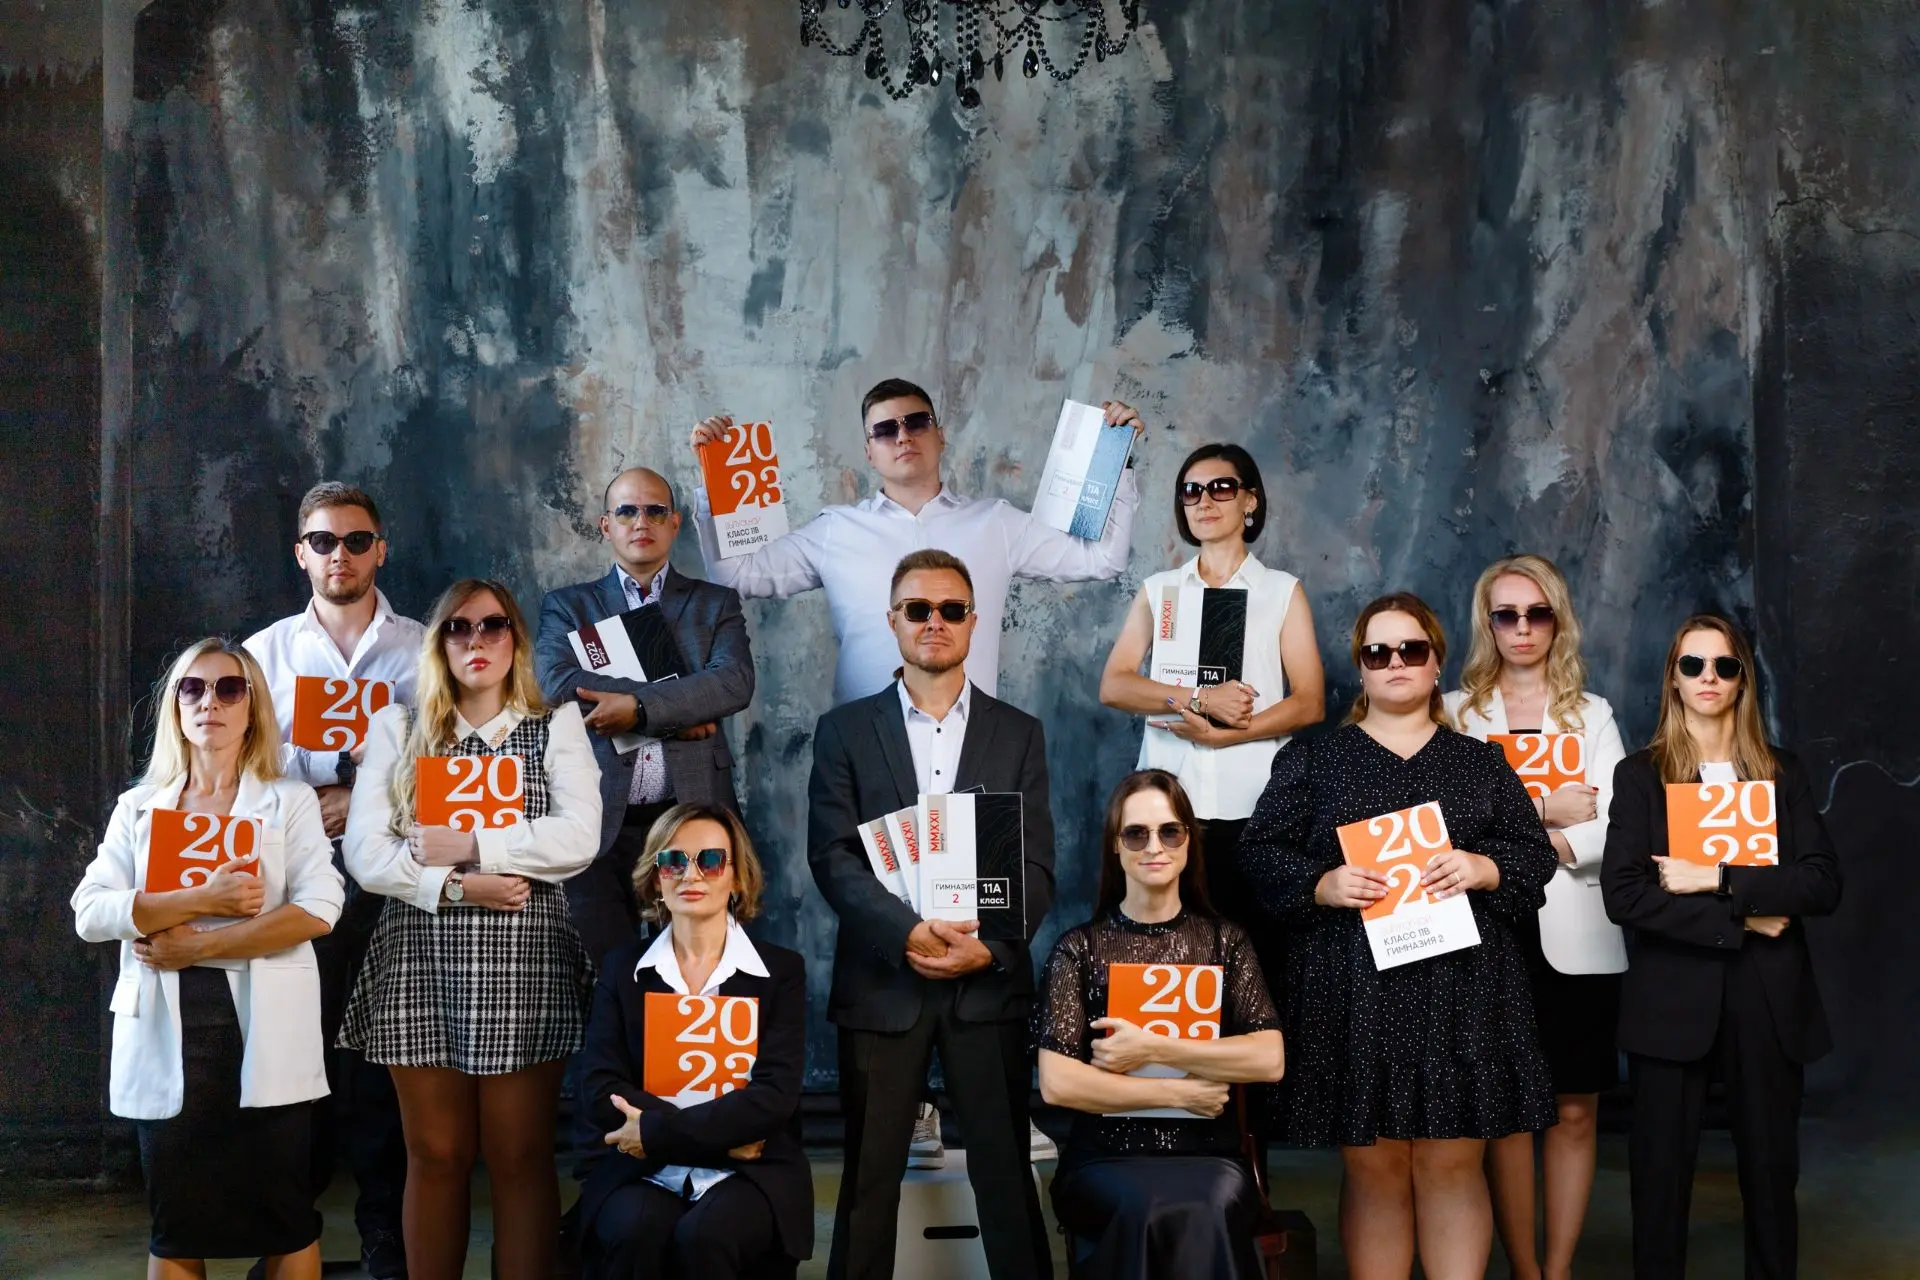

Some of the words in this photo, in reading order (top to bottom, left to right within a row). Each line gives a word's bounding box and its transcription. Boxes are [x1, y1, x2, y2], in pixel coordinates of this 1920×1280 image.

[725, 422, 777, 466] 20
[731, 466, 783, 512] 23
[726, 528, 750, 539] КЛАСС
[728, 536, 764, 548] ГИМНАЗИЯ
[763, 535, 769, 543] 2
[1160, 600, 1172, 639] MMXXII
[585, 641, 601, 667] 2022
[1162, 668, 1197, 676] ГИМНАЗИЯ
[1203, 670, 1219, 681] 11А
[320, 678, 395, 720] 20
[1515, 733, 1585, 776] 20
[444, 755, 524, 802] 20
[1698, 781, 1777, 828] 20
[179, 812, 262, 863] 20
[929, 809, 940, 852] MMXXII
[1368, 801, 1450, 863] 20
[875, 831, 896, 872] MMXXII
[935, 883, 976, 891] ГИМНАЗИЯ
[952, 893, 960, 904] 2
[979, 897, 1005, 905] класс
[982, 883, 1002, 894] 11А
[1383, 930, 1417, 946] КЛАСС
[1386, 937, 1438, 957] ГИМНАЗИЯ
[1438, 934, 1445, 944] 2
[1139, 965, 1224, 1014] 20
[675, 995, 759, 1046] 20
